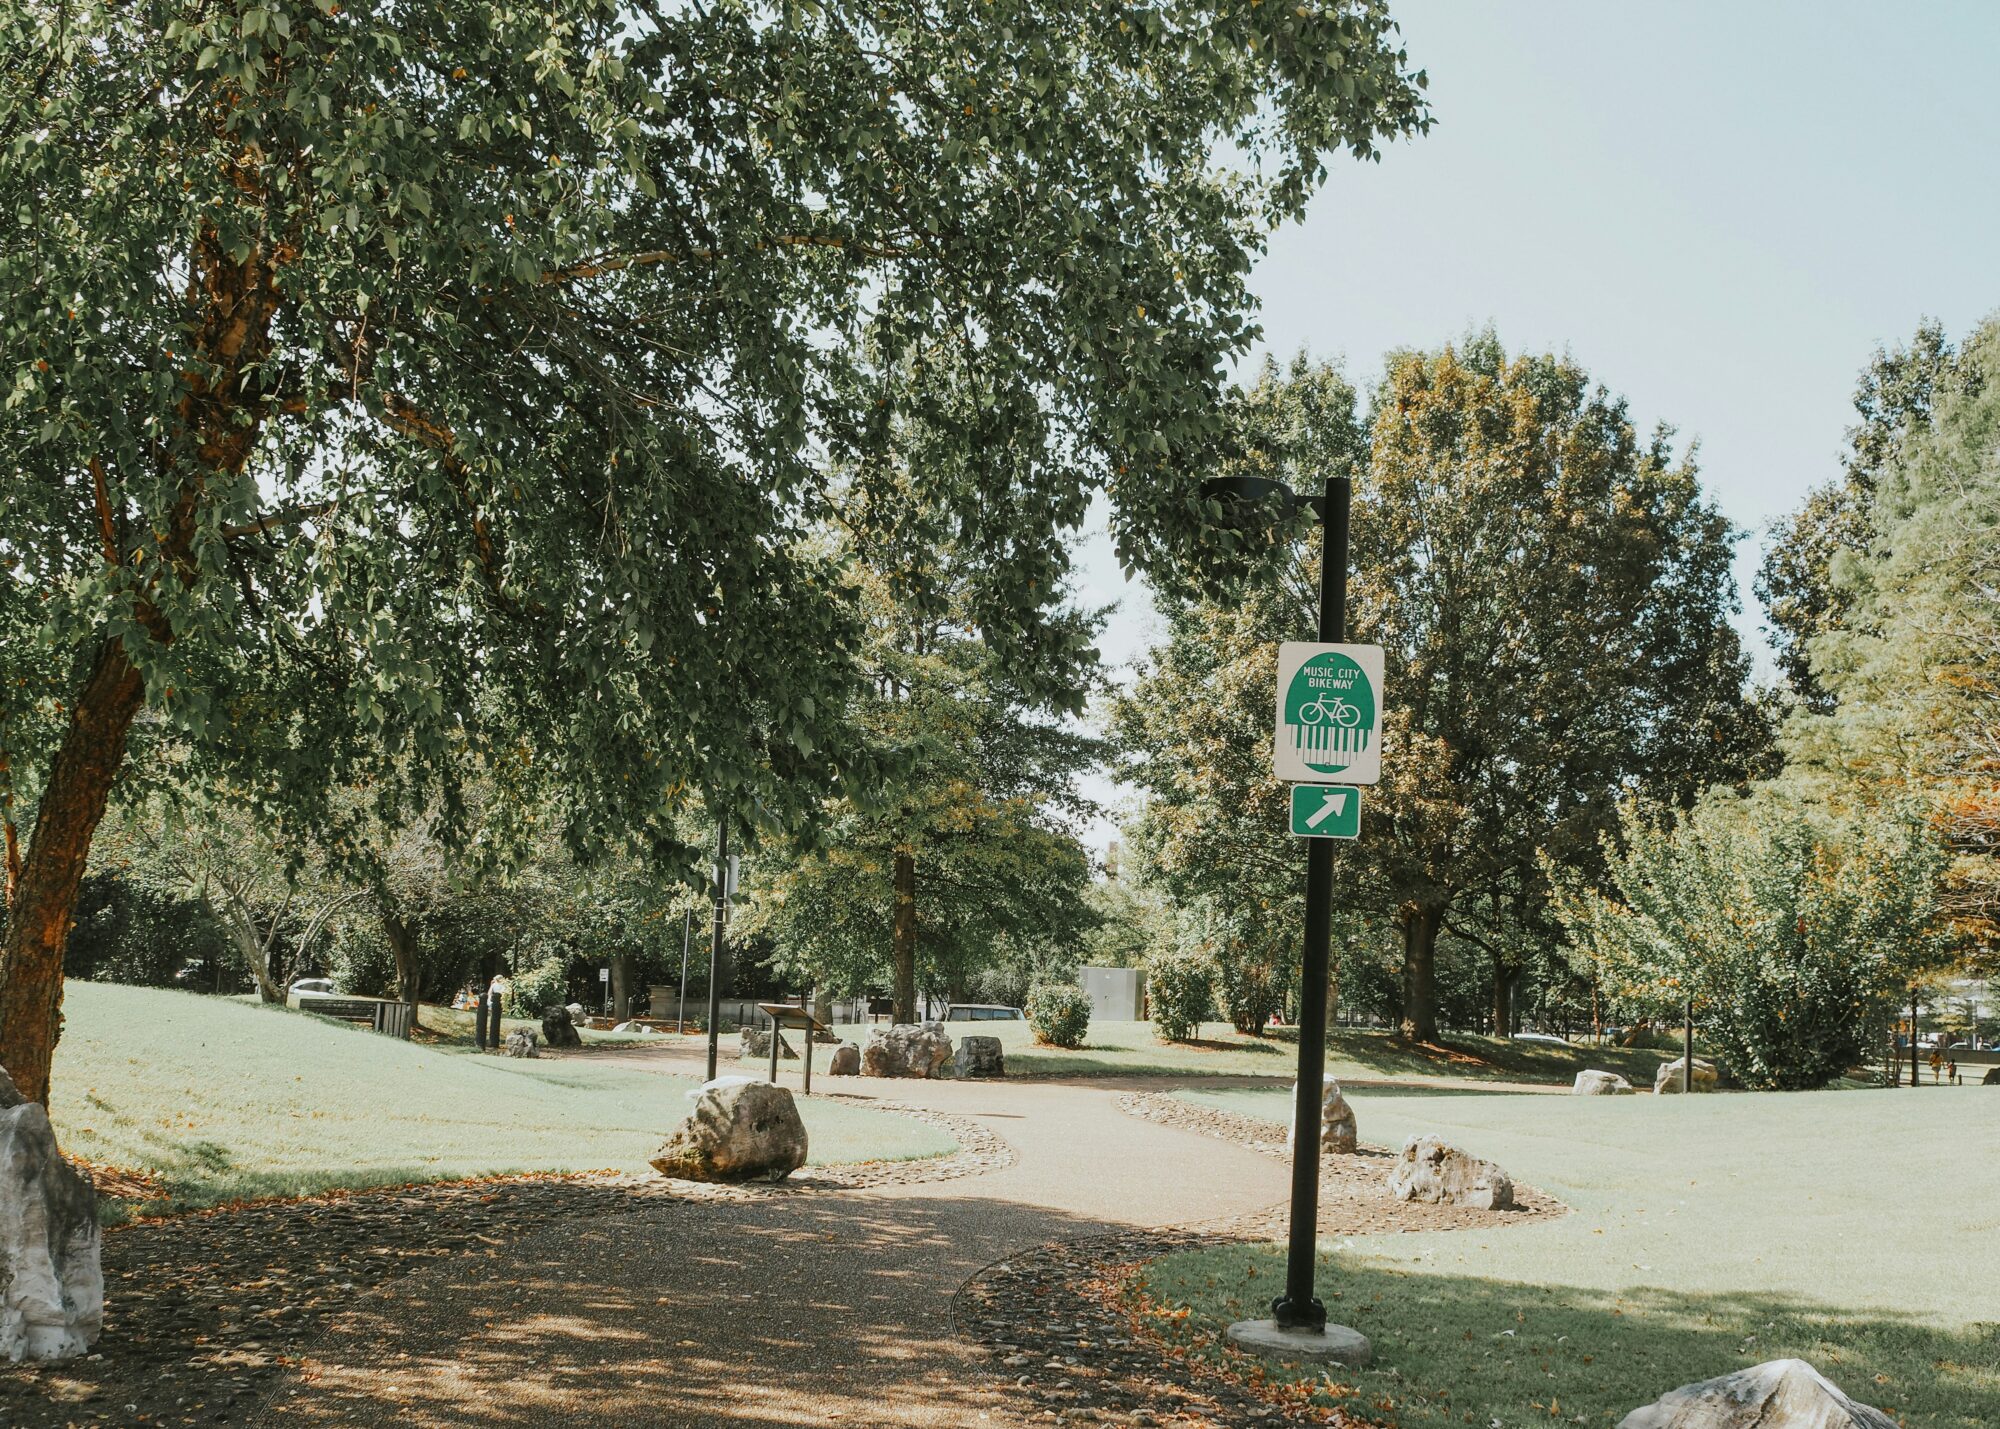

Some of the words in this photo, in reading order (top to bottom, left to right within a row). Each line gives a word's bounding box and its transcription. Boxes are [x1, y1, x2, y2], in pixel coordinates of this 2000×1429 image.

[1303, 666, 1334, 678] MUSIC
[1338, 668, 1360, 679] CITY
[1308, 677, 1354, 690] BIKEWAY
